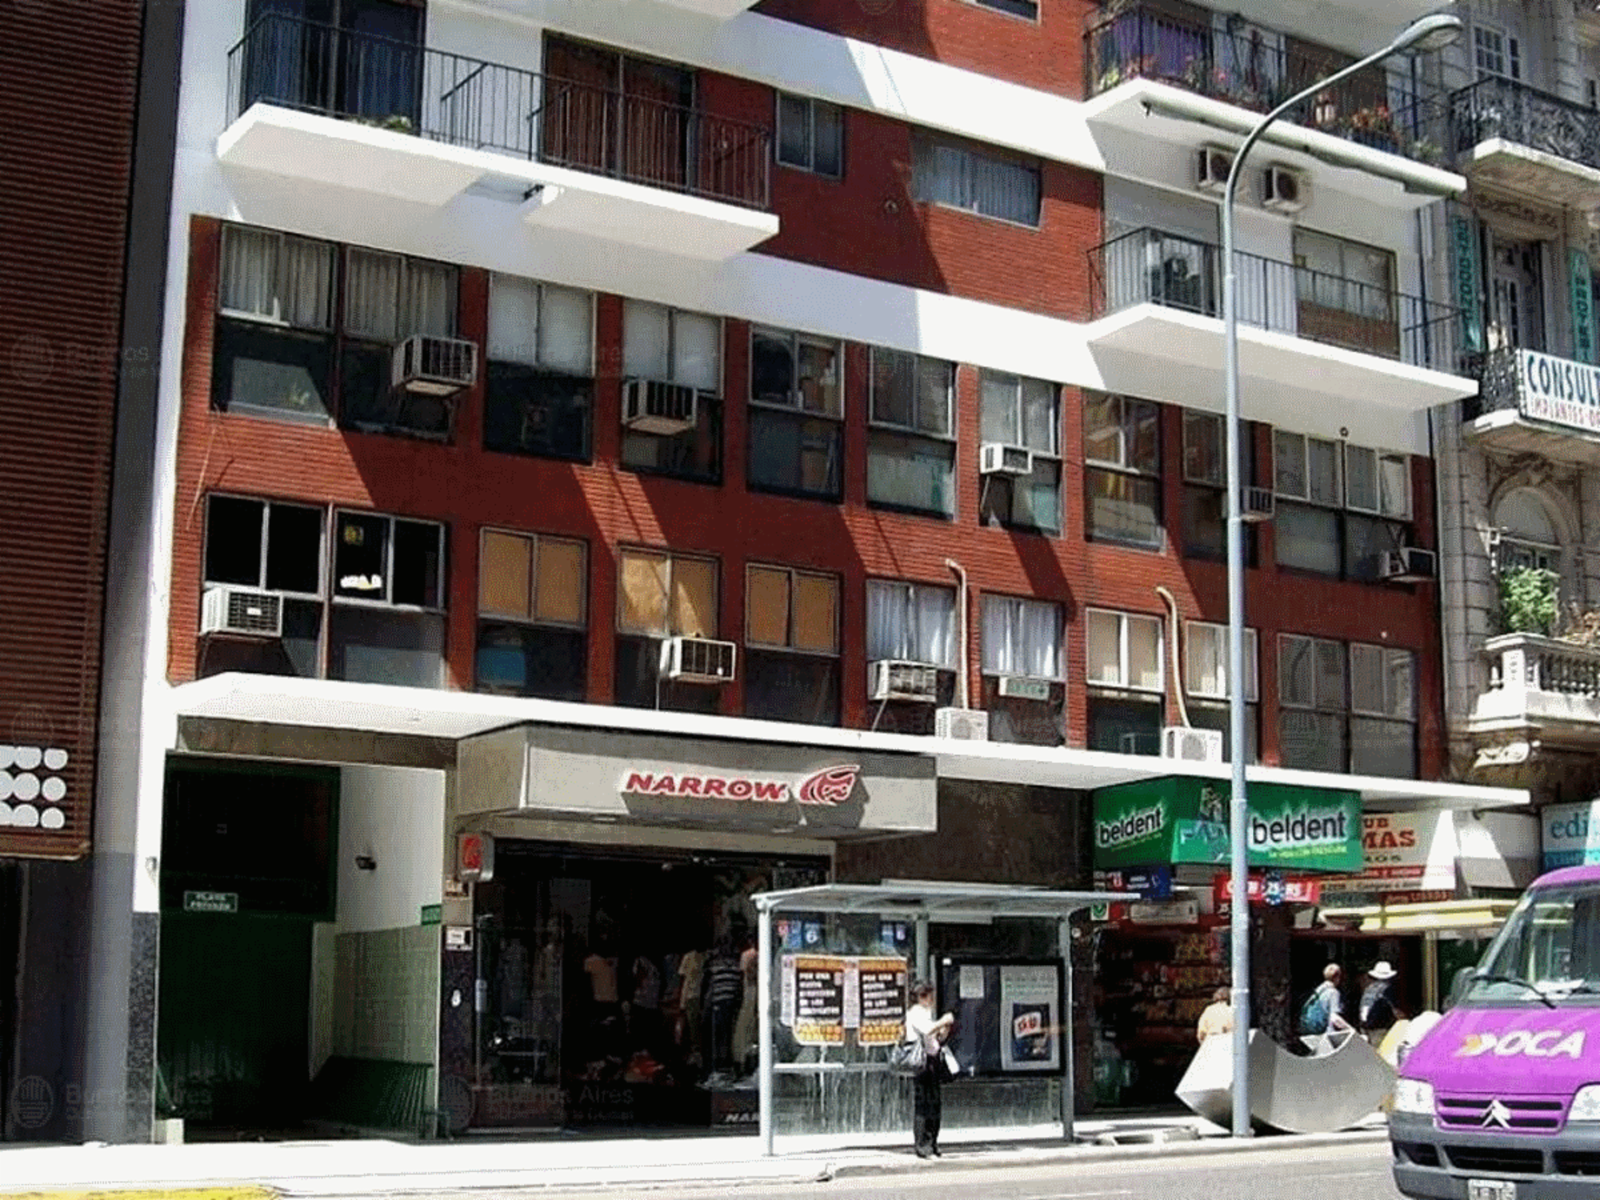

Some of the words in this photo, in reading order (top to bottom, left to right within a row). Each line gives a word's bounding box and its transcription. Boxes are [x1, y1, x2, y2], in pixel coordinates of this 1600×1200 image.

[625, 772, 788, 800] NARROW
[1099, 808, 1162, 846] beldent
[1252, 810, 1346, 844] beldent
